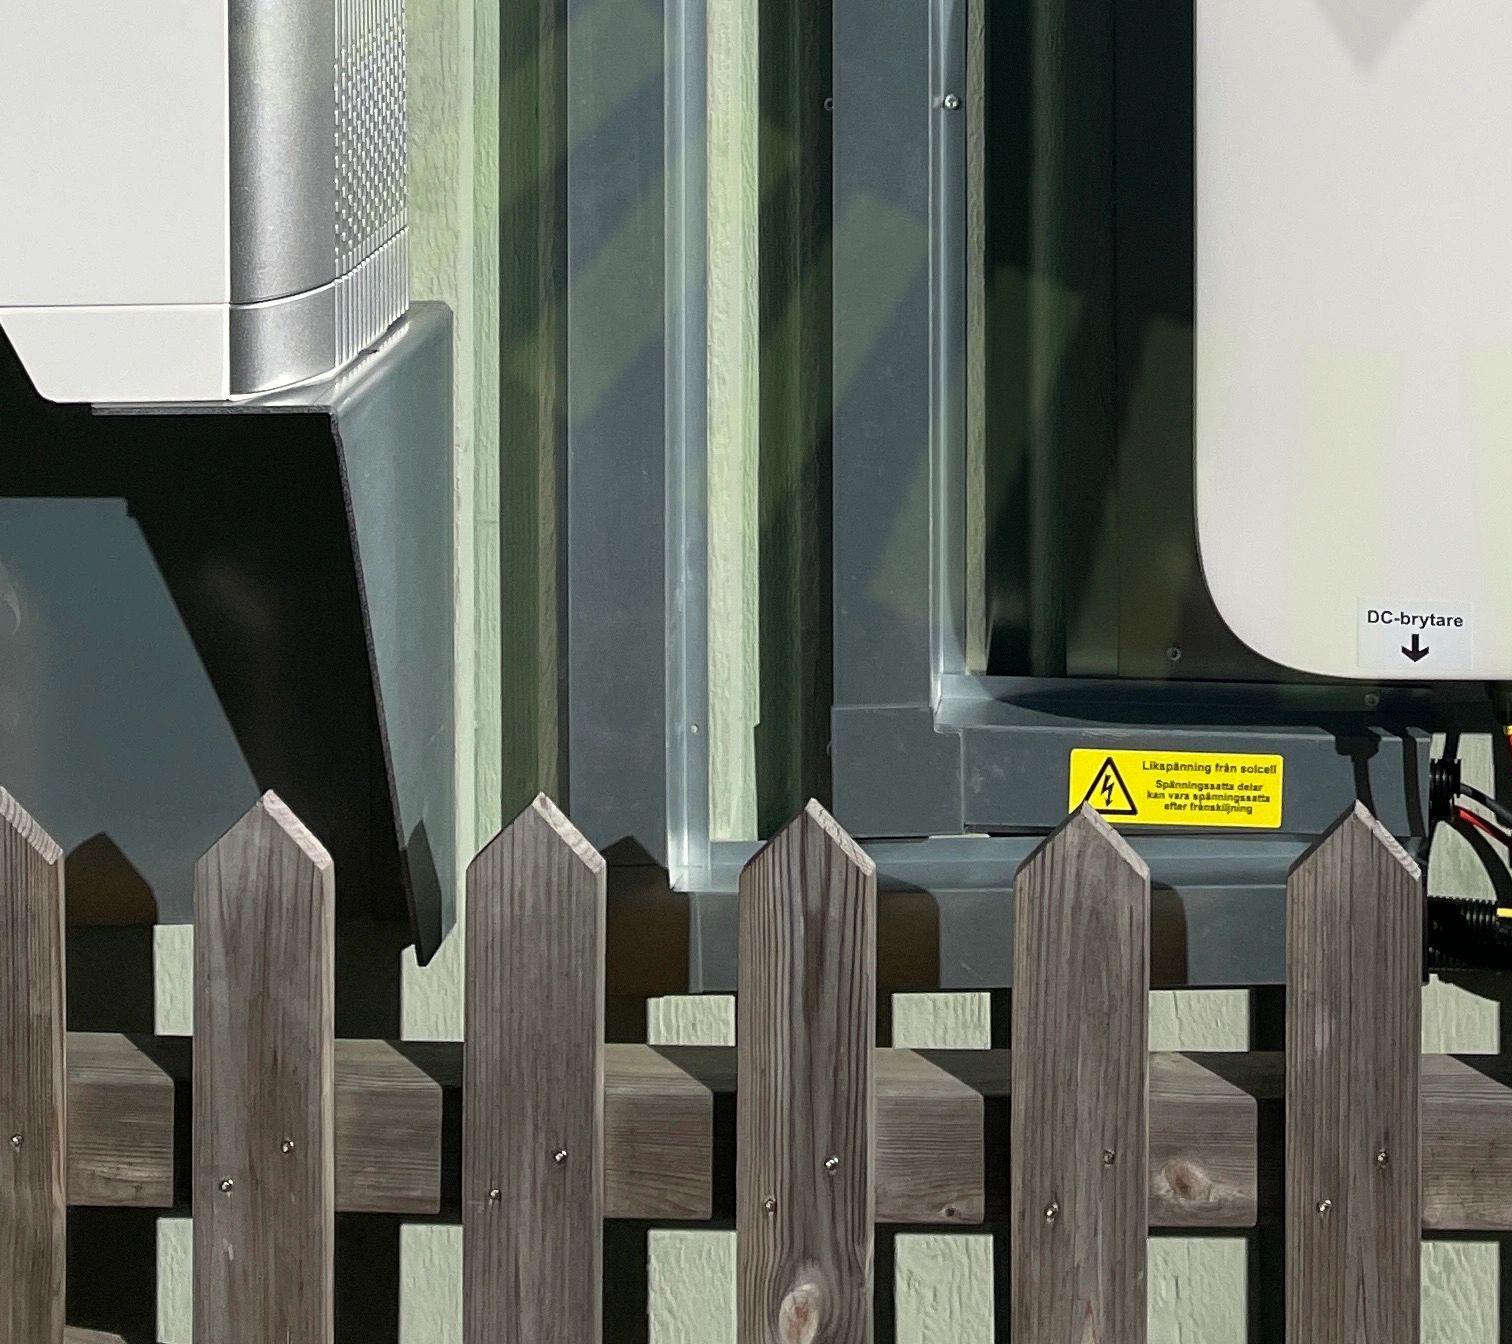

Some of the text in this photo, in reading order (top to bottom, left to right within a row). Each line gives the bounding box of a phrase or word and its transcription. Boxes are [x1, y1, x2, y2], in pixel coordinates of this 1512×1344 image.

[1368, 610, 1463, 629] DC-brytare
[1143, 761, 1276, 774] Likspänning från solcell
[1237, 783, 1263, 791] delar
